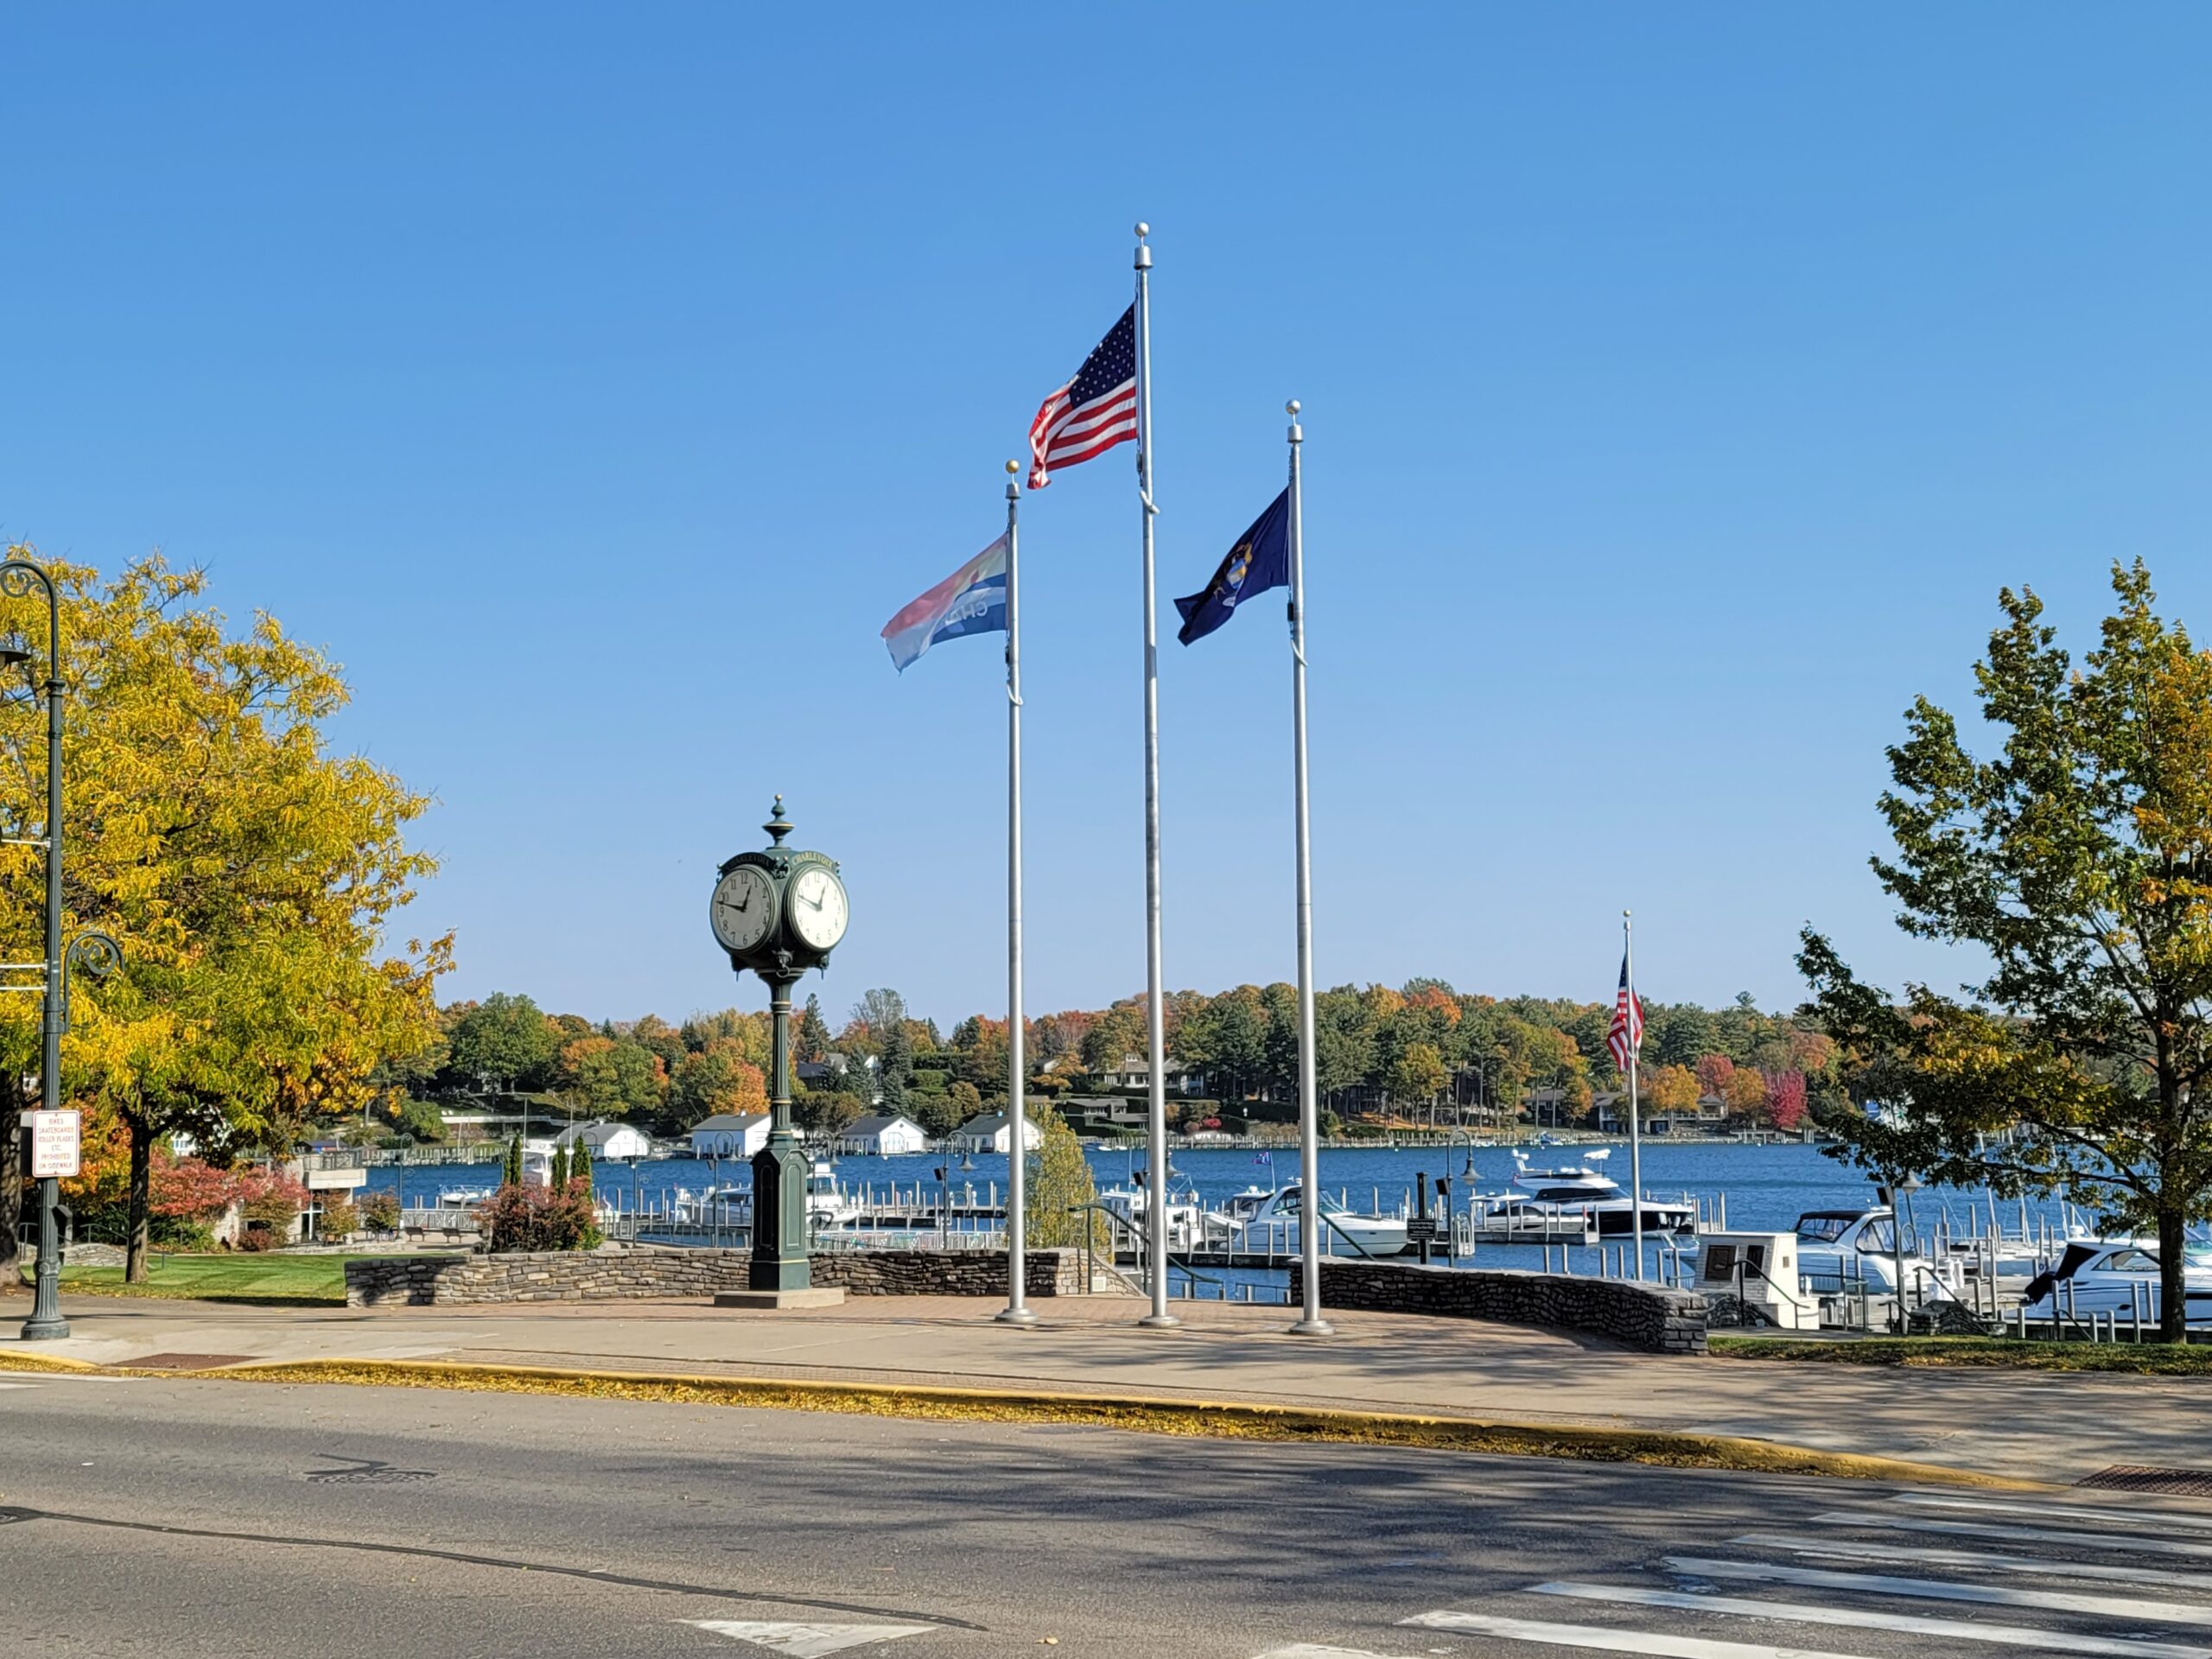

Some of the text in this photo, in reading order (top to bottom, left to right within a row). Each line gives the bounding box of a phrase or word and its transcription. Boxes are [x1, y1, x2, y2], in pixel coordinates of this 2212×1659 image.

[791, 852, 833, 869] CHARLEVOIX
[730, 878, 737, 890] 11
[741, 874, 748, 885] 12
[719, 906, 724, 918] 9
[722, 920, 728, 931] 8
[730, 931, 736, 943] 7
[742, 934, 748, 945] 6
[754, 929, 760, 939] 5
